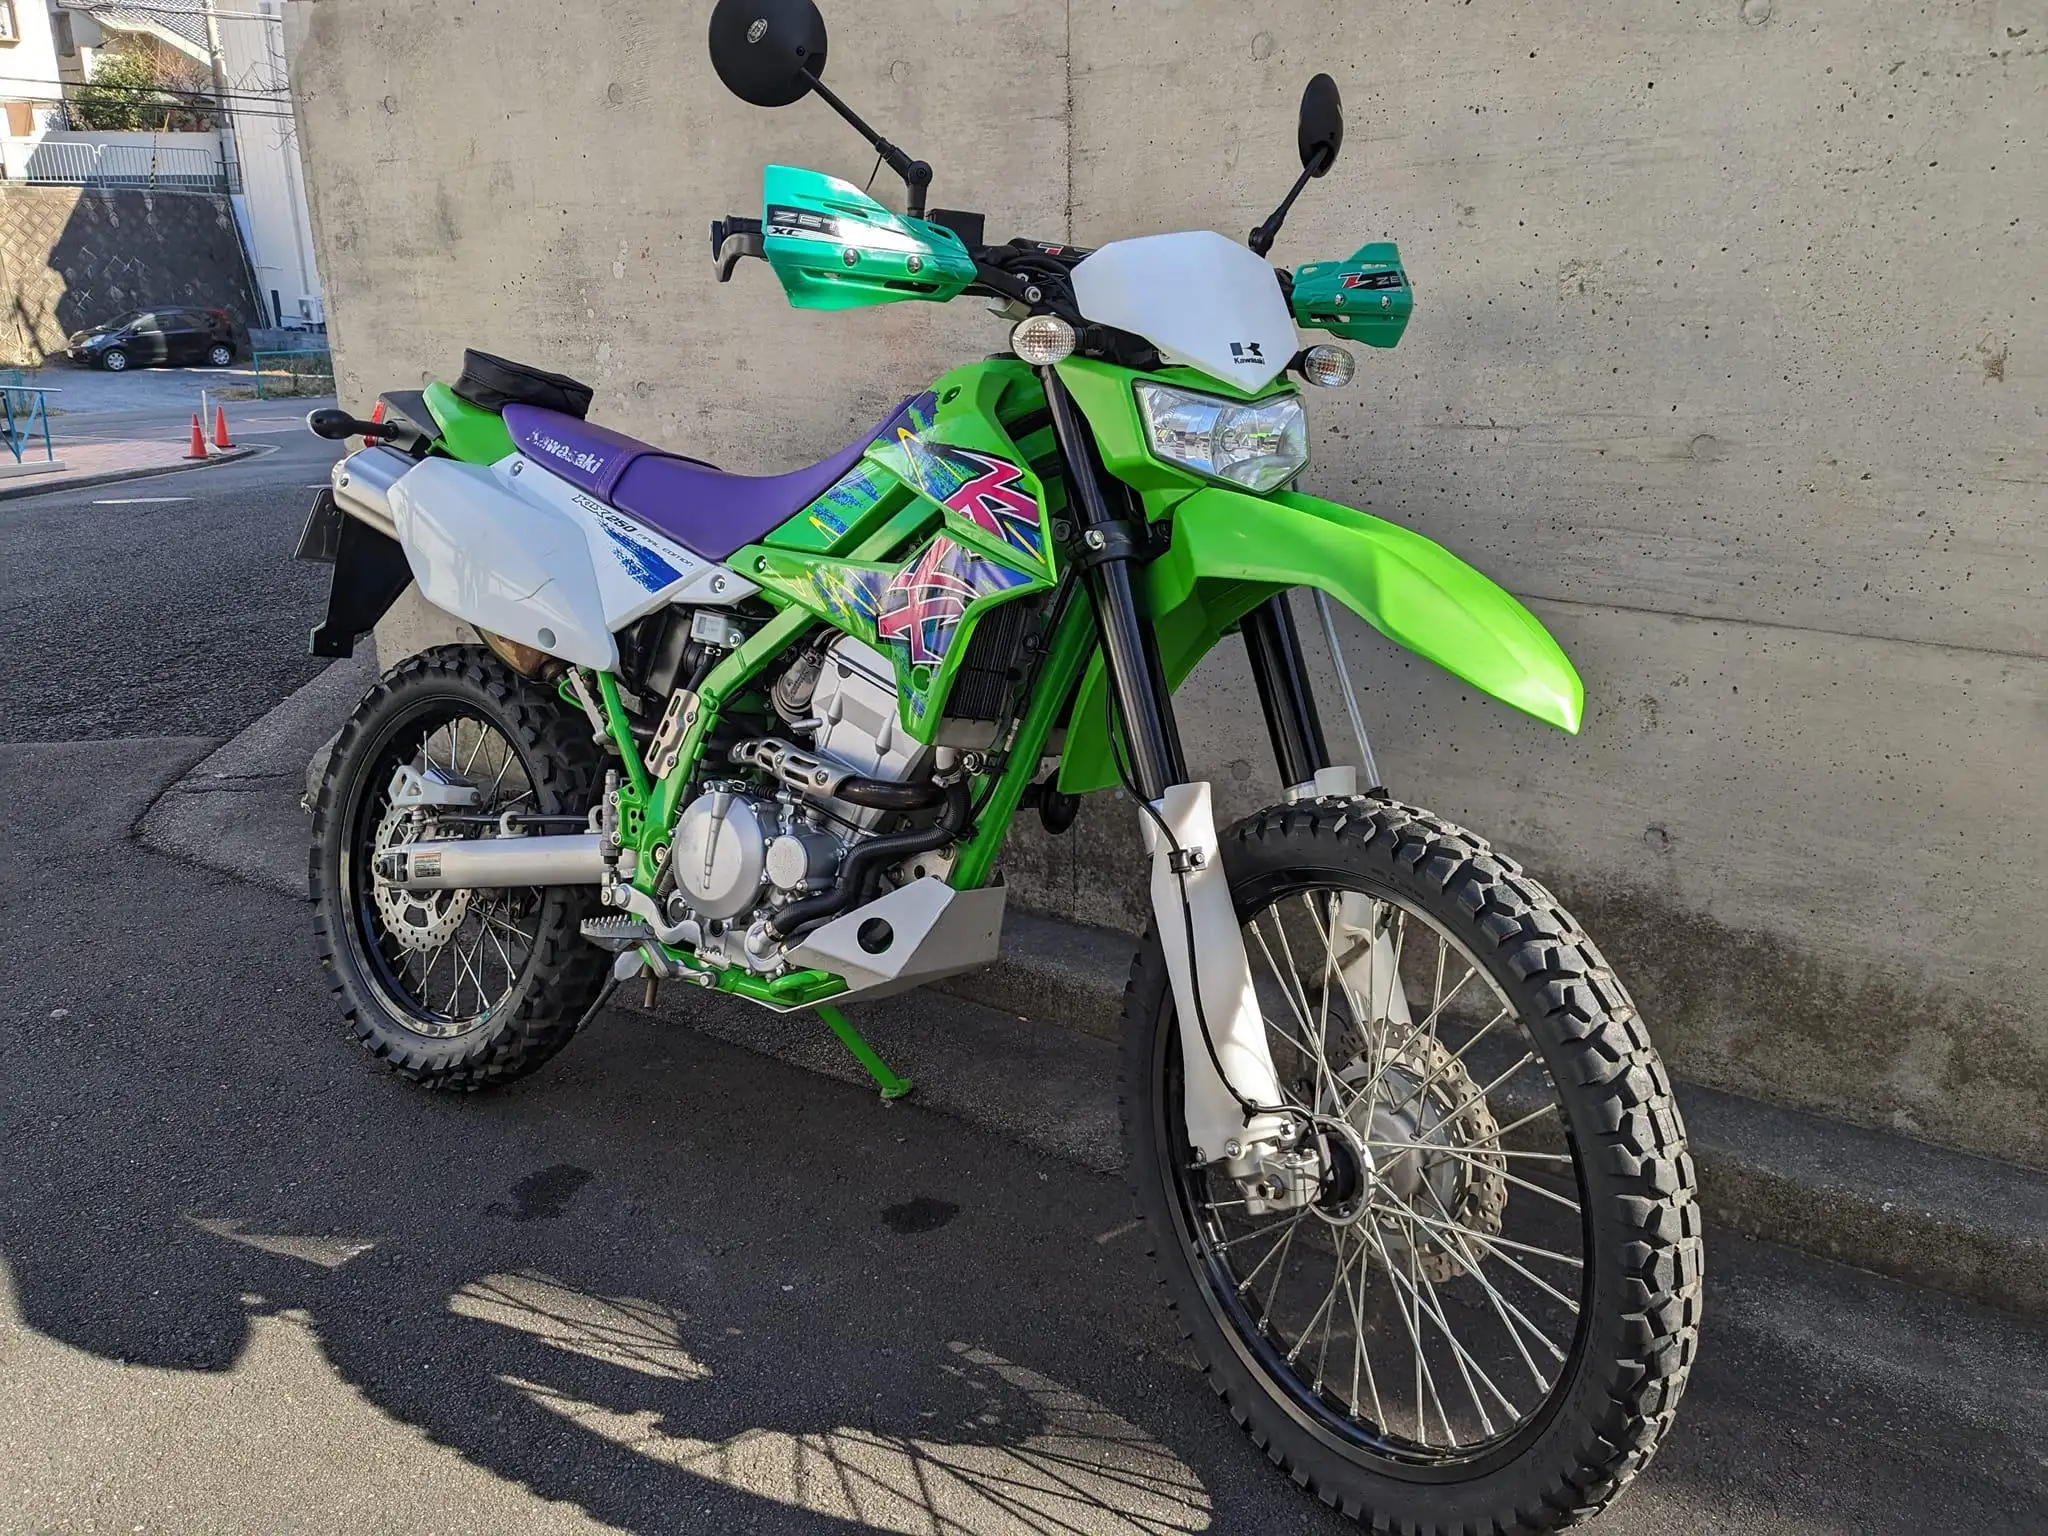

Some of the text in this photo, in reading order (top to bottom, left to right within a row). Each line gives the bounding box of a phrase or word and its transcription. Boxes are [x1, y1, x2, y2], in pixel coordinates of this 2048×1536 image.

[772, 227, 802, 236] XC
[1233, 357, 1266, 365] Kawasaki
[526, 430, 604, 474] Kawasaki
[662, 548, 694, 567] EDITION
